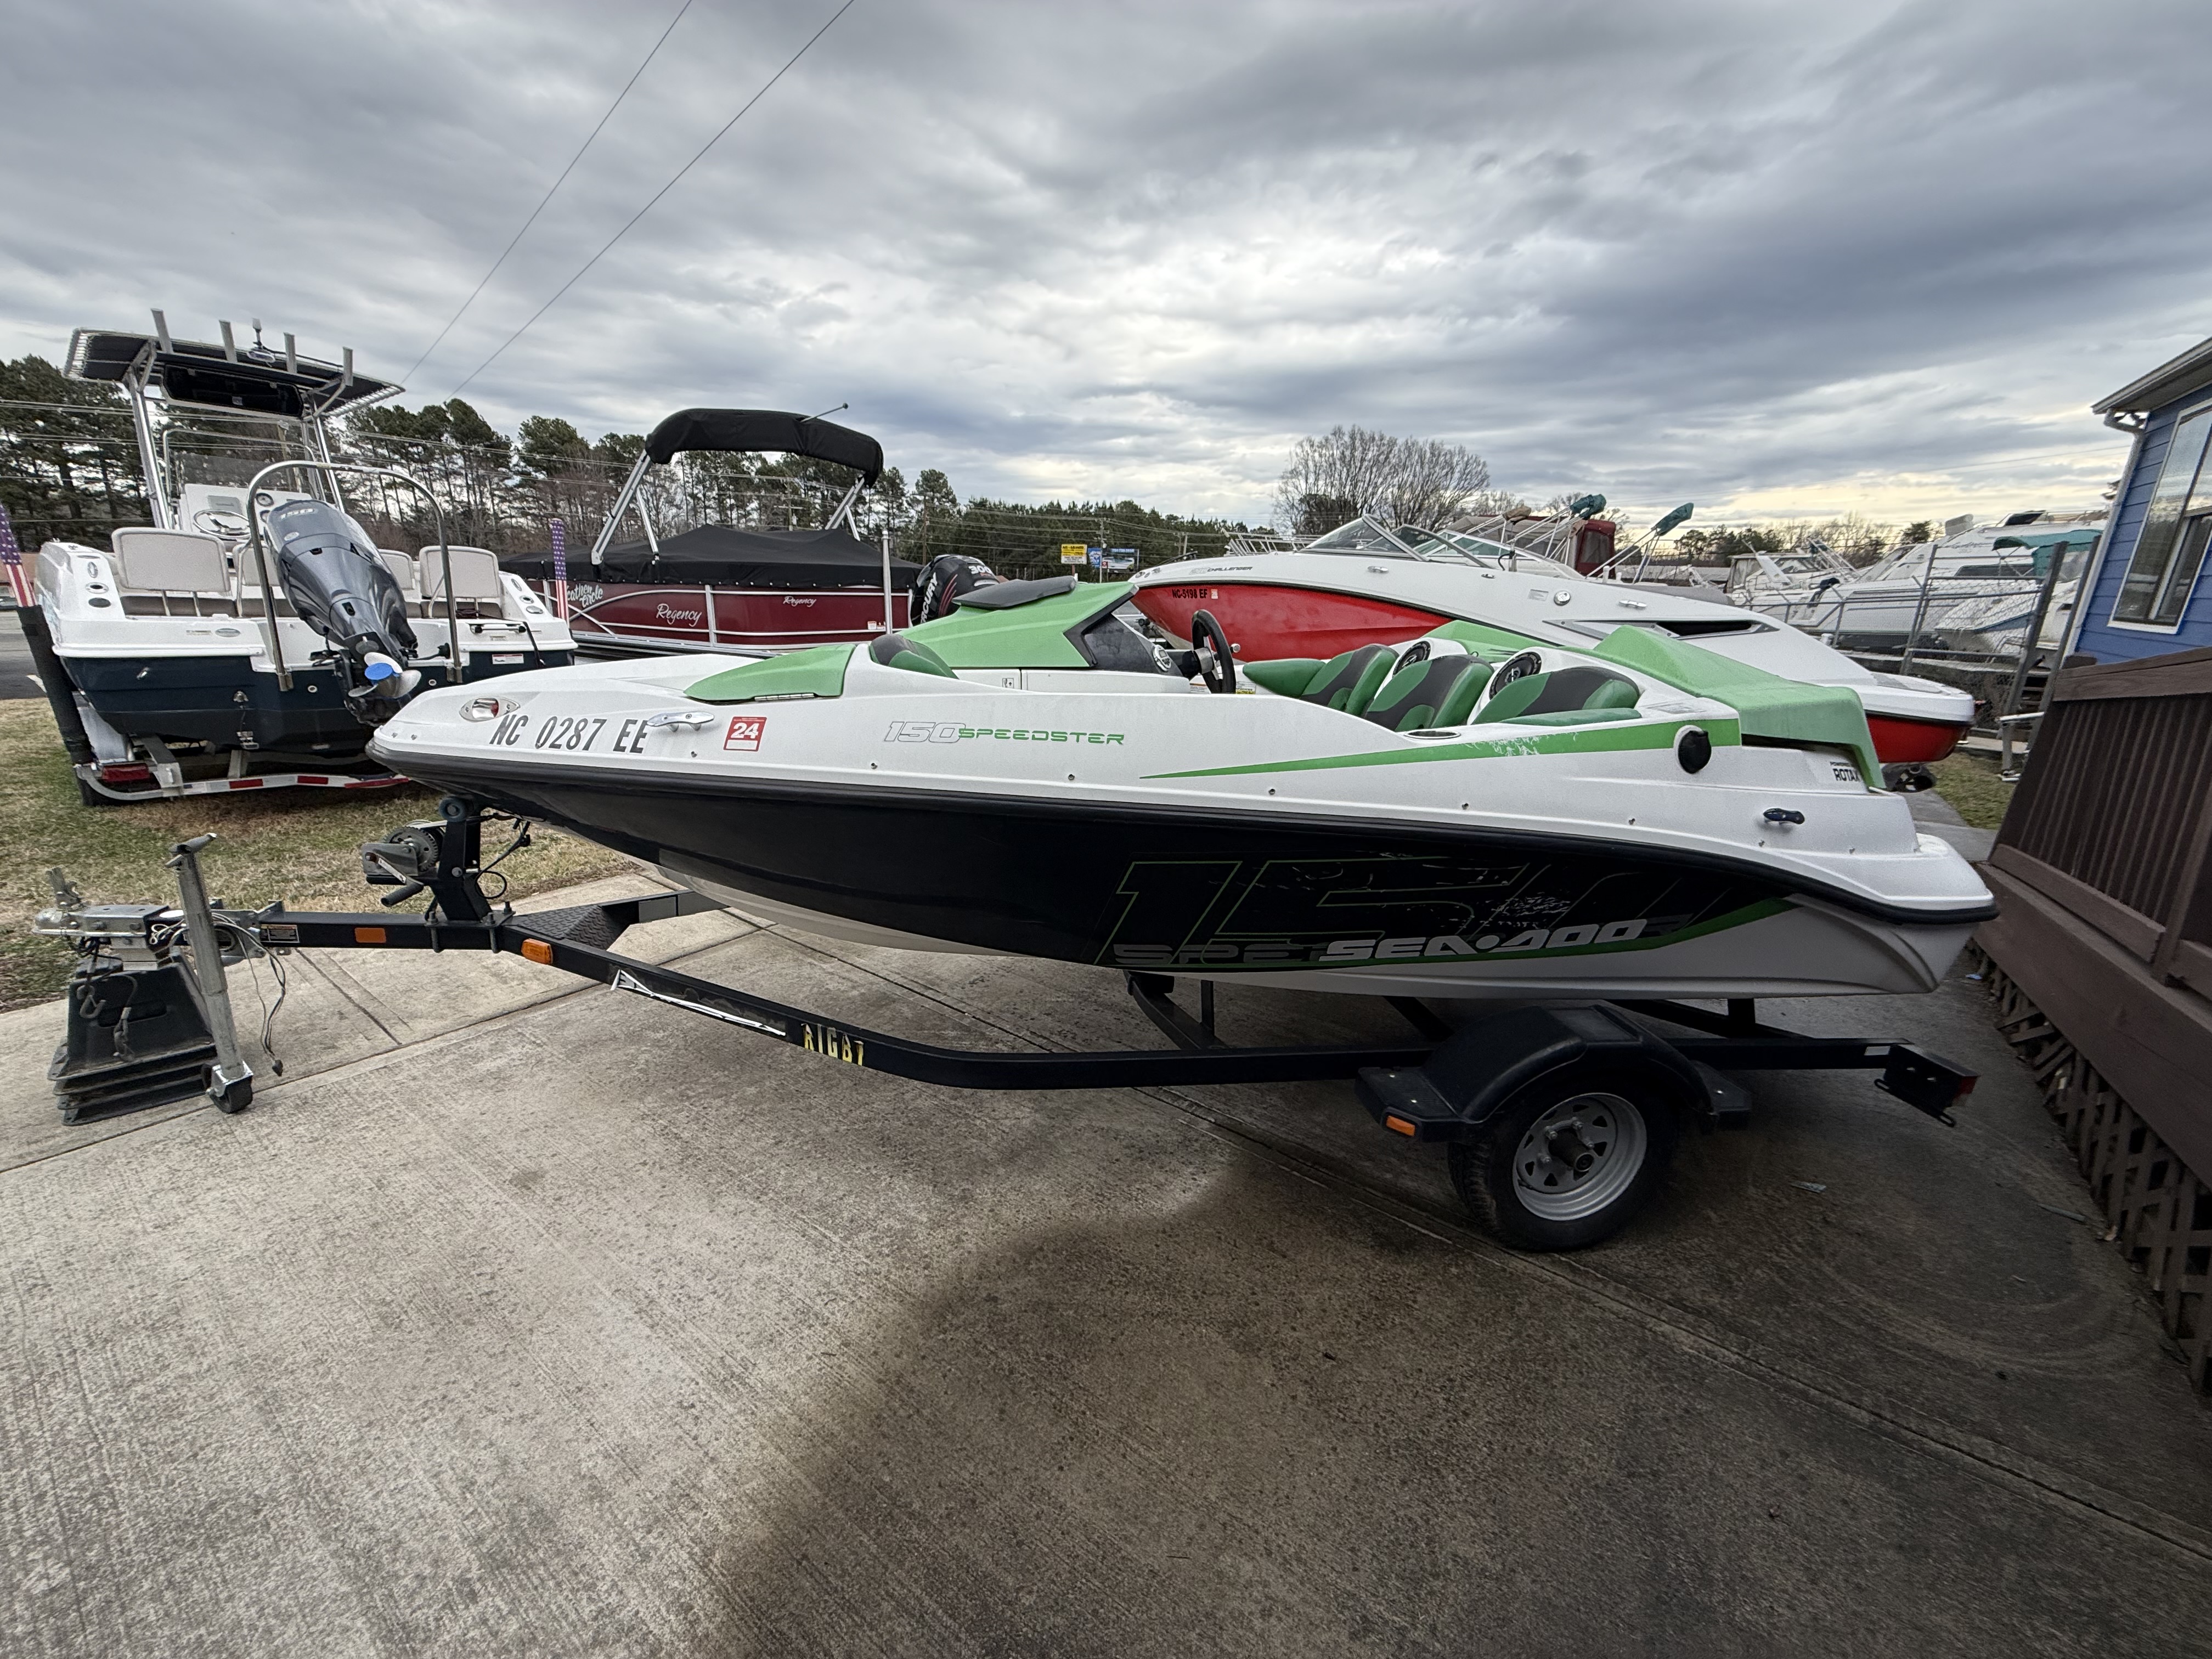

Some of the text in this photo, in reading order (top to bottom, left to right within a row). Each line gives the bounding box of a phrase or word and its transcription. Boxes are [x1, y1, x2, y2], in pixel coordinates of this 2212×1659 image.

[968, 565, 993, 574] 300
[783, 596, 817, 607] Regency
[921, 572, 938, 623] RCURY
[1199, 589, 1207, 599] EF
[656, 603, 702, 627] Regency
[489, 714, 648, 754] NC 0287 EE
[730, 722, 760, 739] 24
[884, 721, 1125, 745] 150 SPEEDSTER
[1832, 768, 1861, 782] ROTAX
